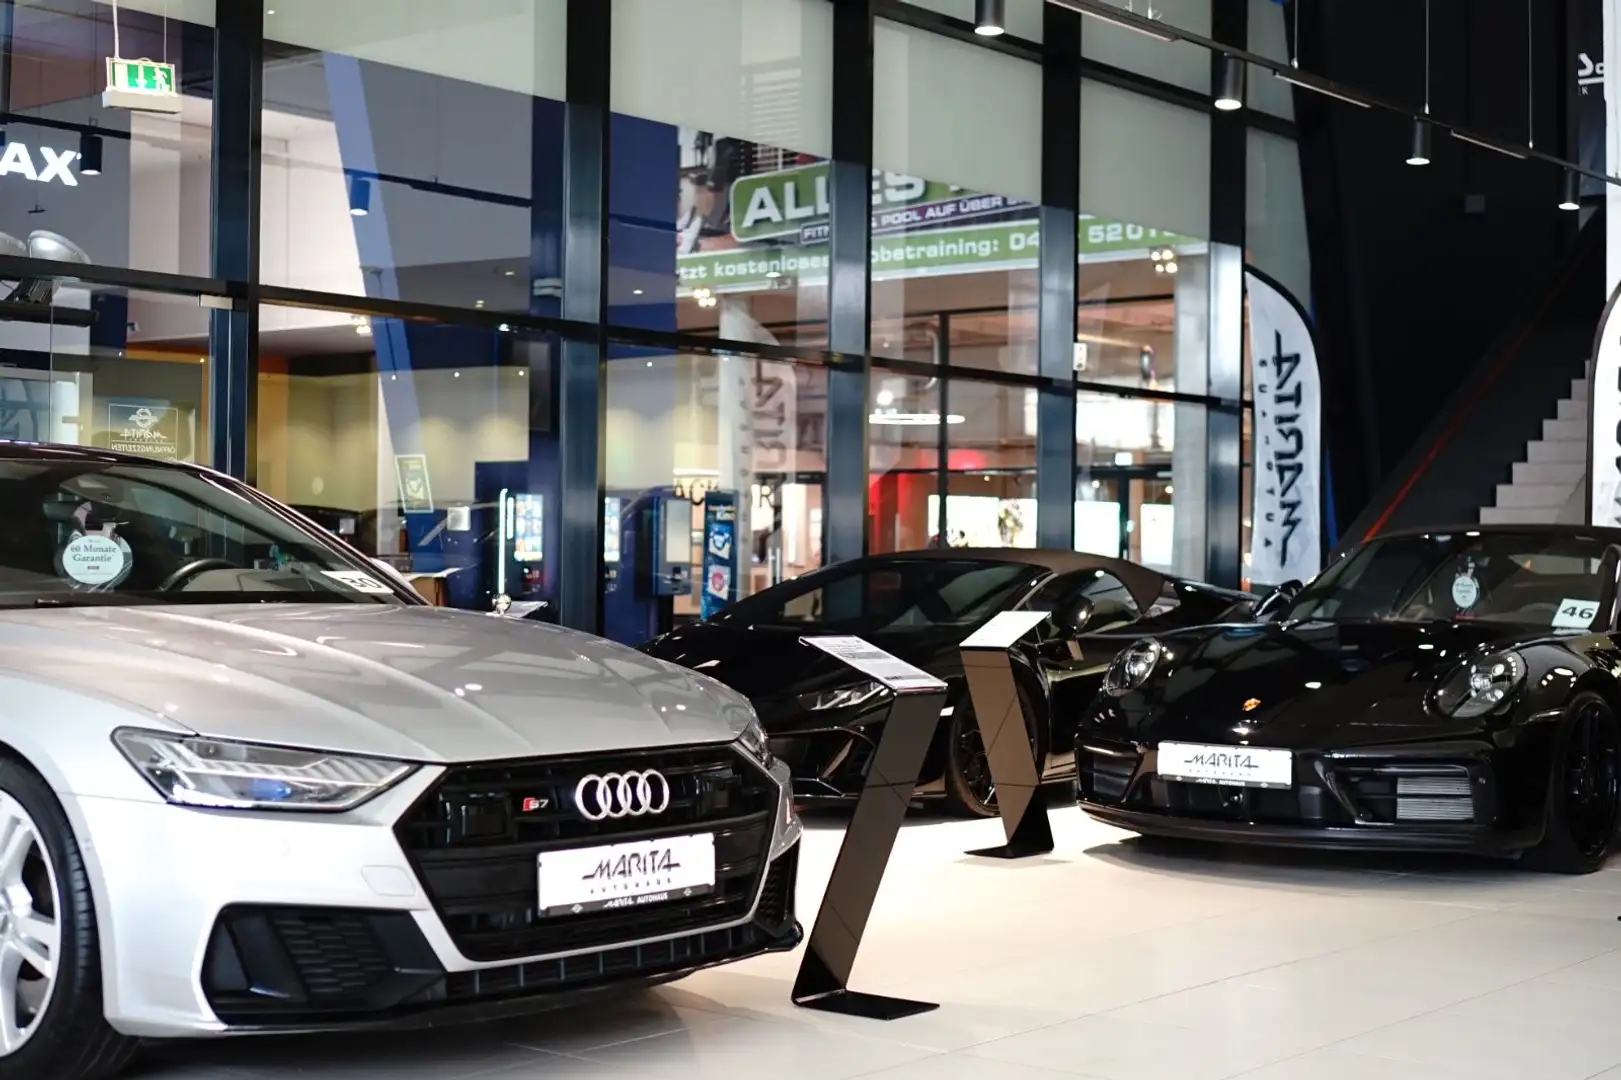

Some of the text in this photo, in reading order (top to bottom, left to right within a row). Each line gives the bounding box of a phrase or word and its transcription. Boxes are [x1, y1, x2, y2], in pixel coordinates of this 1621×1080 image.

[881, 209, 922, 227] POOL
[925, 203, 957, 219] AUF
[84, 544, 117, 554] Monate
[1561, 606, 1595, 620] 46
[1183, 752, 1260, 770] MARITA
[582, 848, 681, 880] MARITA
[636, 891, 668, 905] AUTOHAUS
